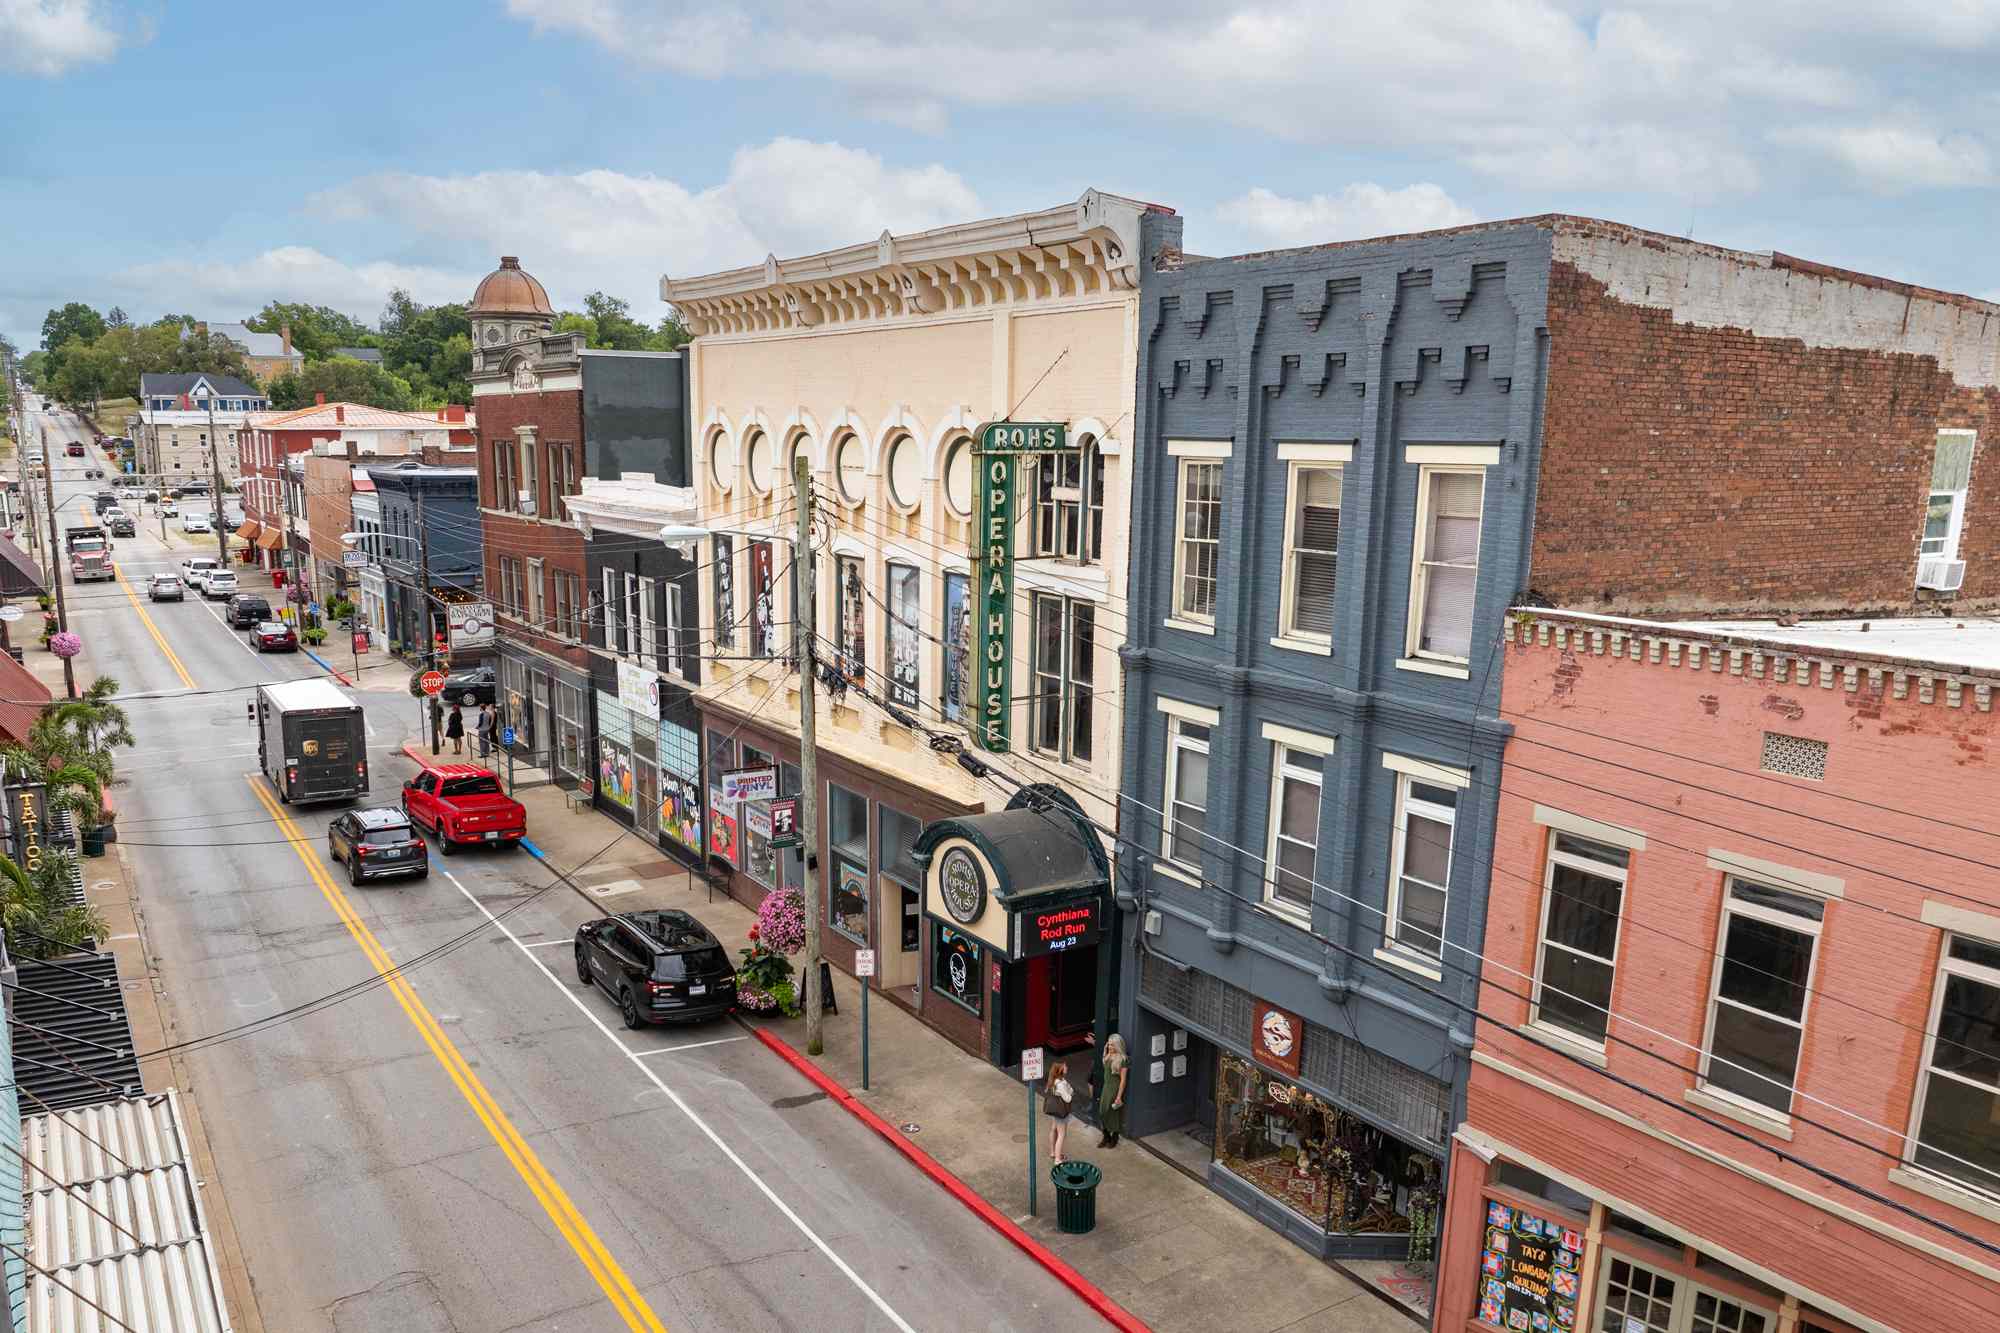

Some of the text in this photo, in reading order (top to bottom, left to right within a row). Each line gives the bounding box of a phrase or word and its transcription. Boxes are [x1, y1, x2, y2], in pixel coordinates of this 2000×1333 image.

[994, 427, 1056, 448] ROHS
[986, 460, 1007, 742] OPERA HOUSE
[422, 677, 443, 688] STOP
[735, 775, 773, 785] PRINTED
[736, 782, 773, 793] VINYL
[949, 876, 977, 897] OPERA
[951, 888, 974, 911] HOUSE
[1038, 909, 1089, 927] Cynthiana
[1040, 923, 1086, 940] Rod Run
[1050, 936, 1077, 951] Aug 23
[1511, 1260, 1552, 1283] LONGARM
[1513, 1276, 1549, 1297] QUILTING
